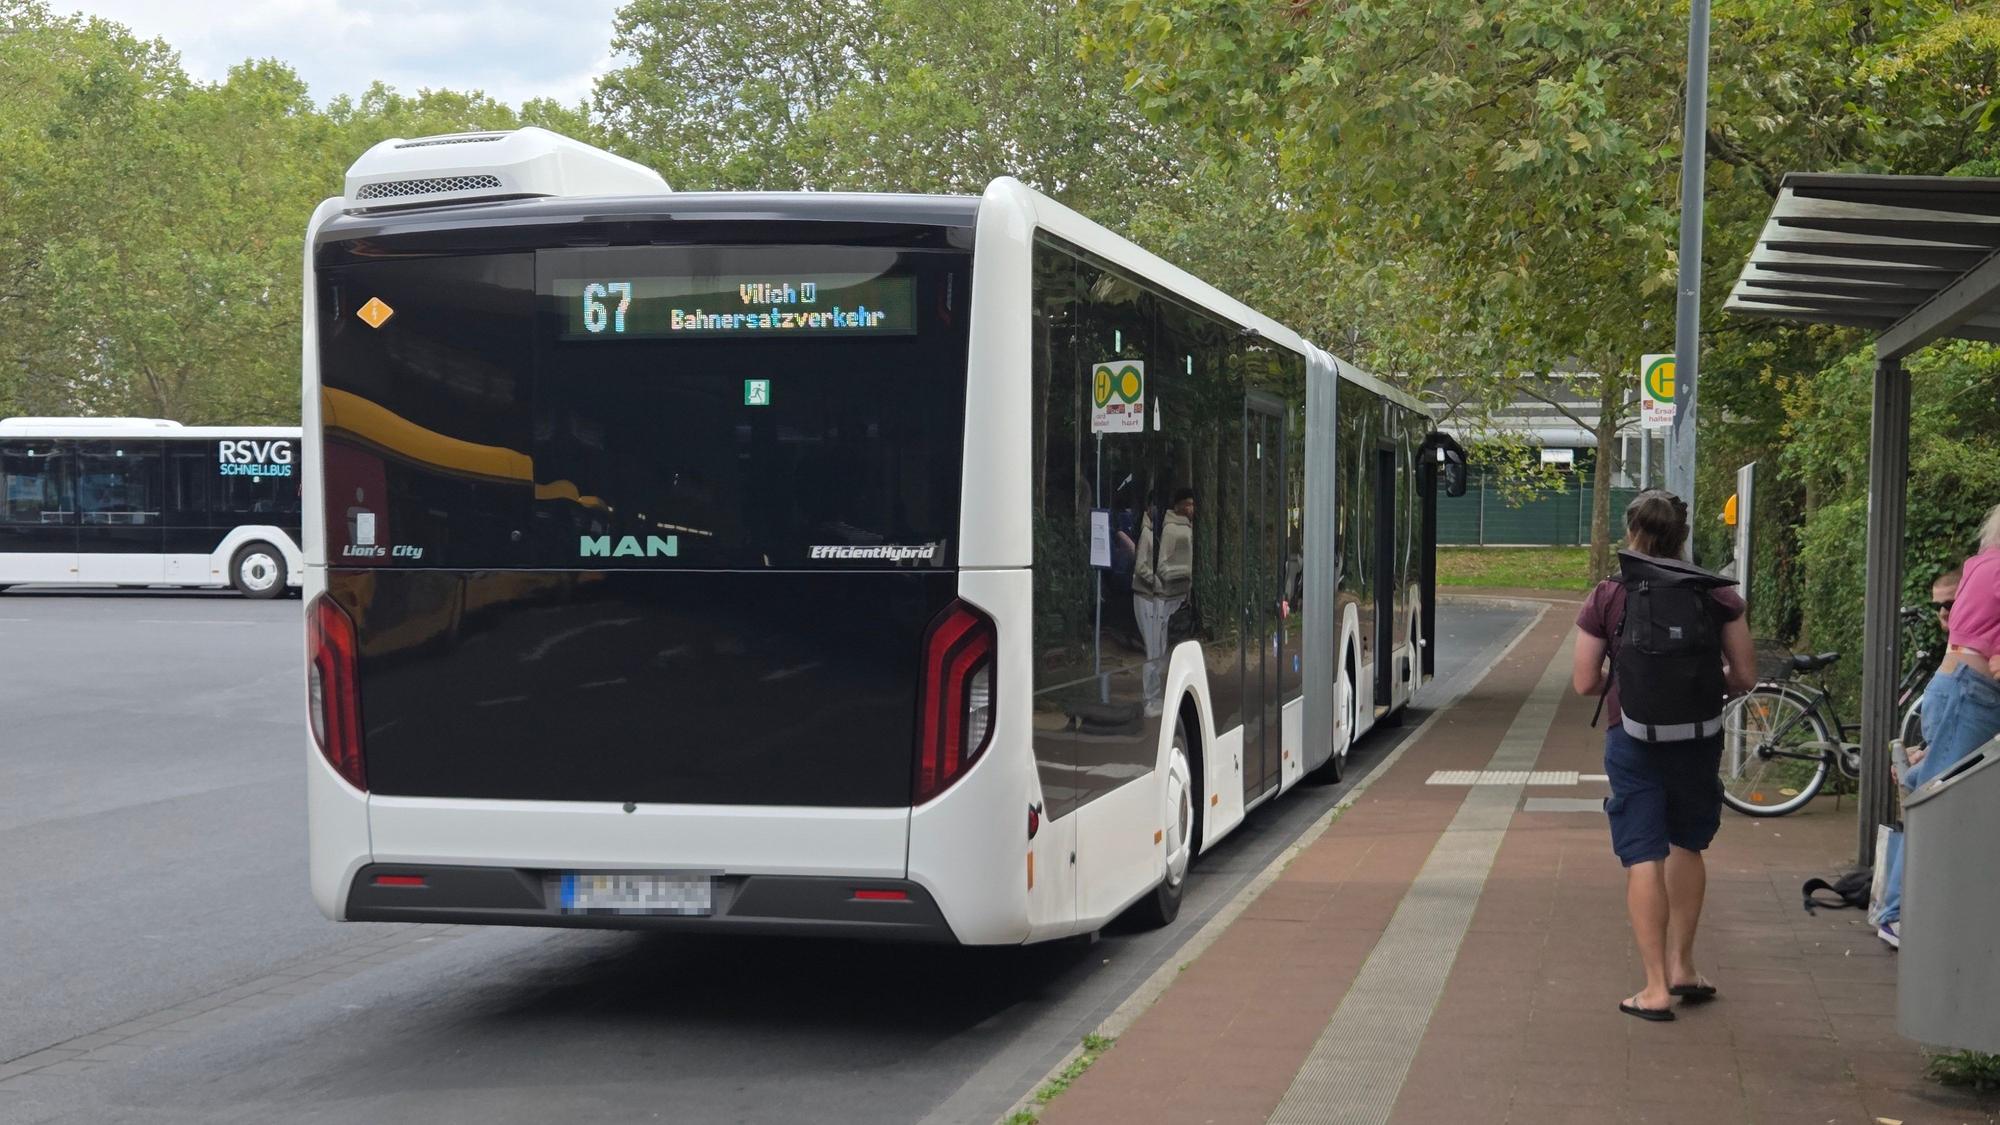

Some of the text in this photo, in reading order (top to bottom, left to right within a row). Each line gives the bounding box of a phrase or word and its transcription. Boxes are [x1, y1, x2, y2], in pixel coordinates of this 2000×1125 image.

[739, 283, 796, 304] Vilich
[584, 282, 632, 332] 67
[671, 306, 885, 330] Bahnersatzverkehr
[219, 440, 291, 463] RSVG
[220, 464, 291, 476] SCHNELLBUS
[342, 545, 424, 559] Lion's City
[580, 535, 678, 557] MAN
[811, 545, 935, 561] EfficientHybrid
